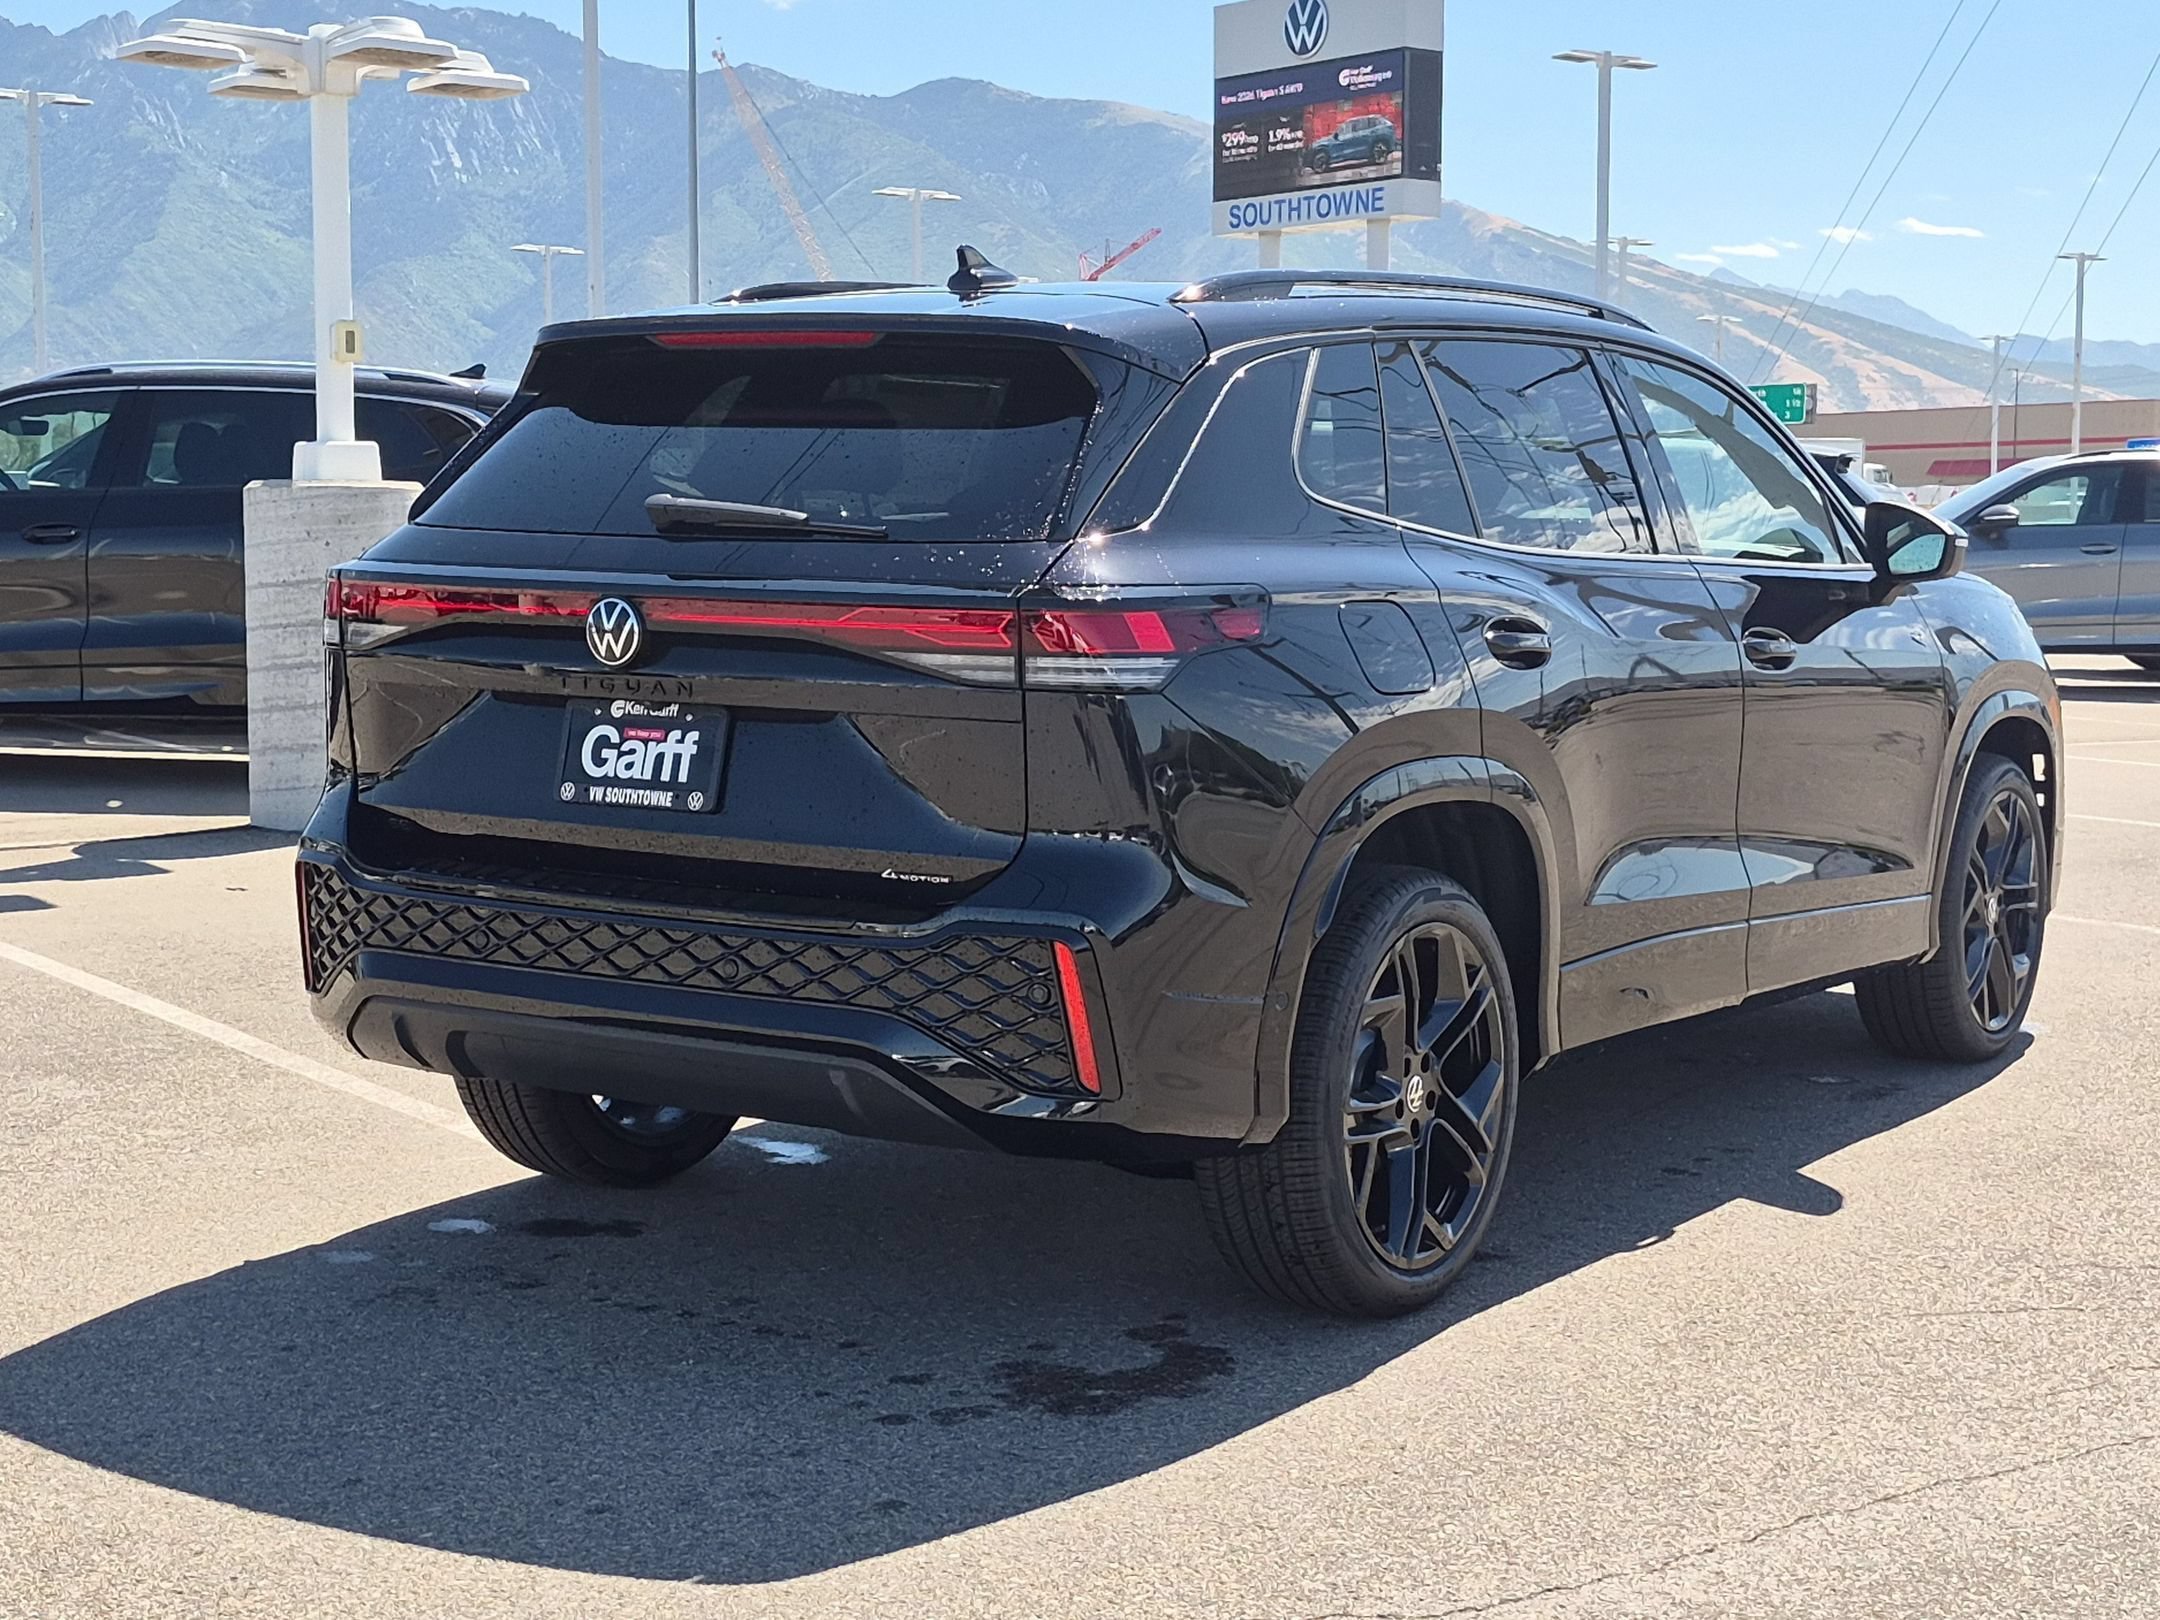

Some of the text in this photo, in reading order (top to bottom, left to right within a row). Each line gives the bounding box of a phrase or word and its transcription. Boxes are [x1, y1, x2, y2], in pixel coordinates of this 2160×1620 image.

[1229, 187, 1385, 229] SOUTHTOWNE
[586, 598, 638, 665] VW
[581, 724, 699, 783] Garff
[589, 785, 673, 807] VW SOUTHTOWNE
[881, 868, 951, 884] 4MOTION
